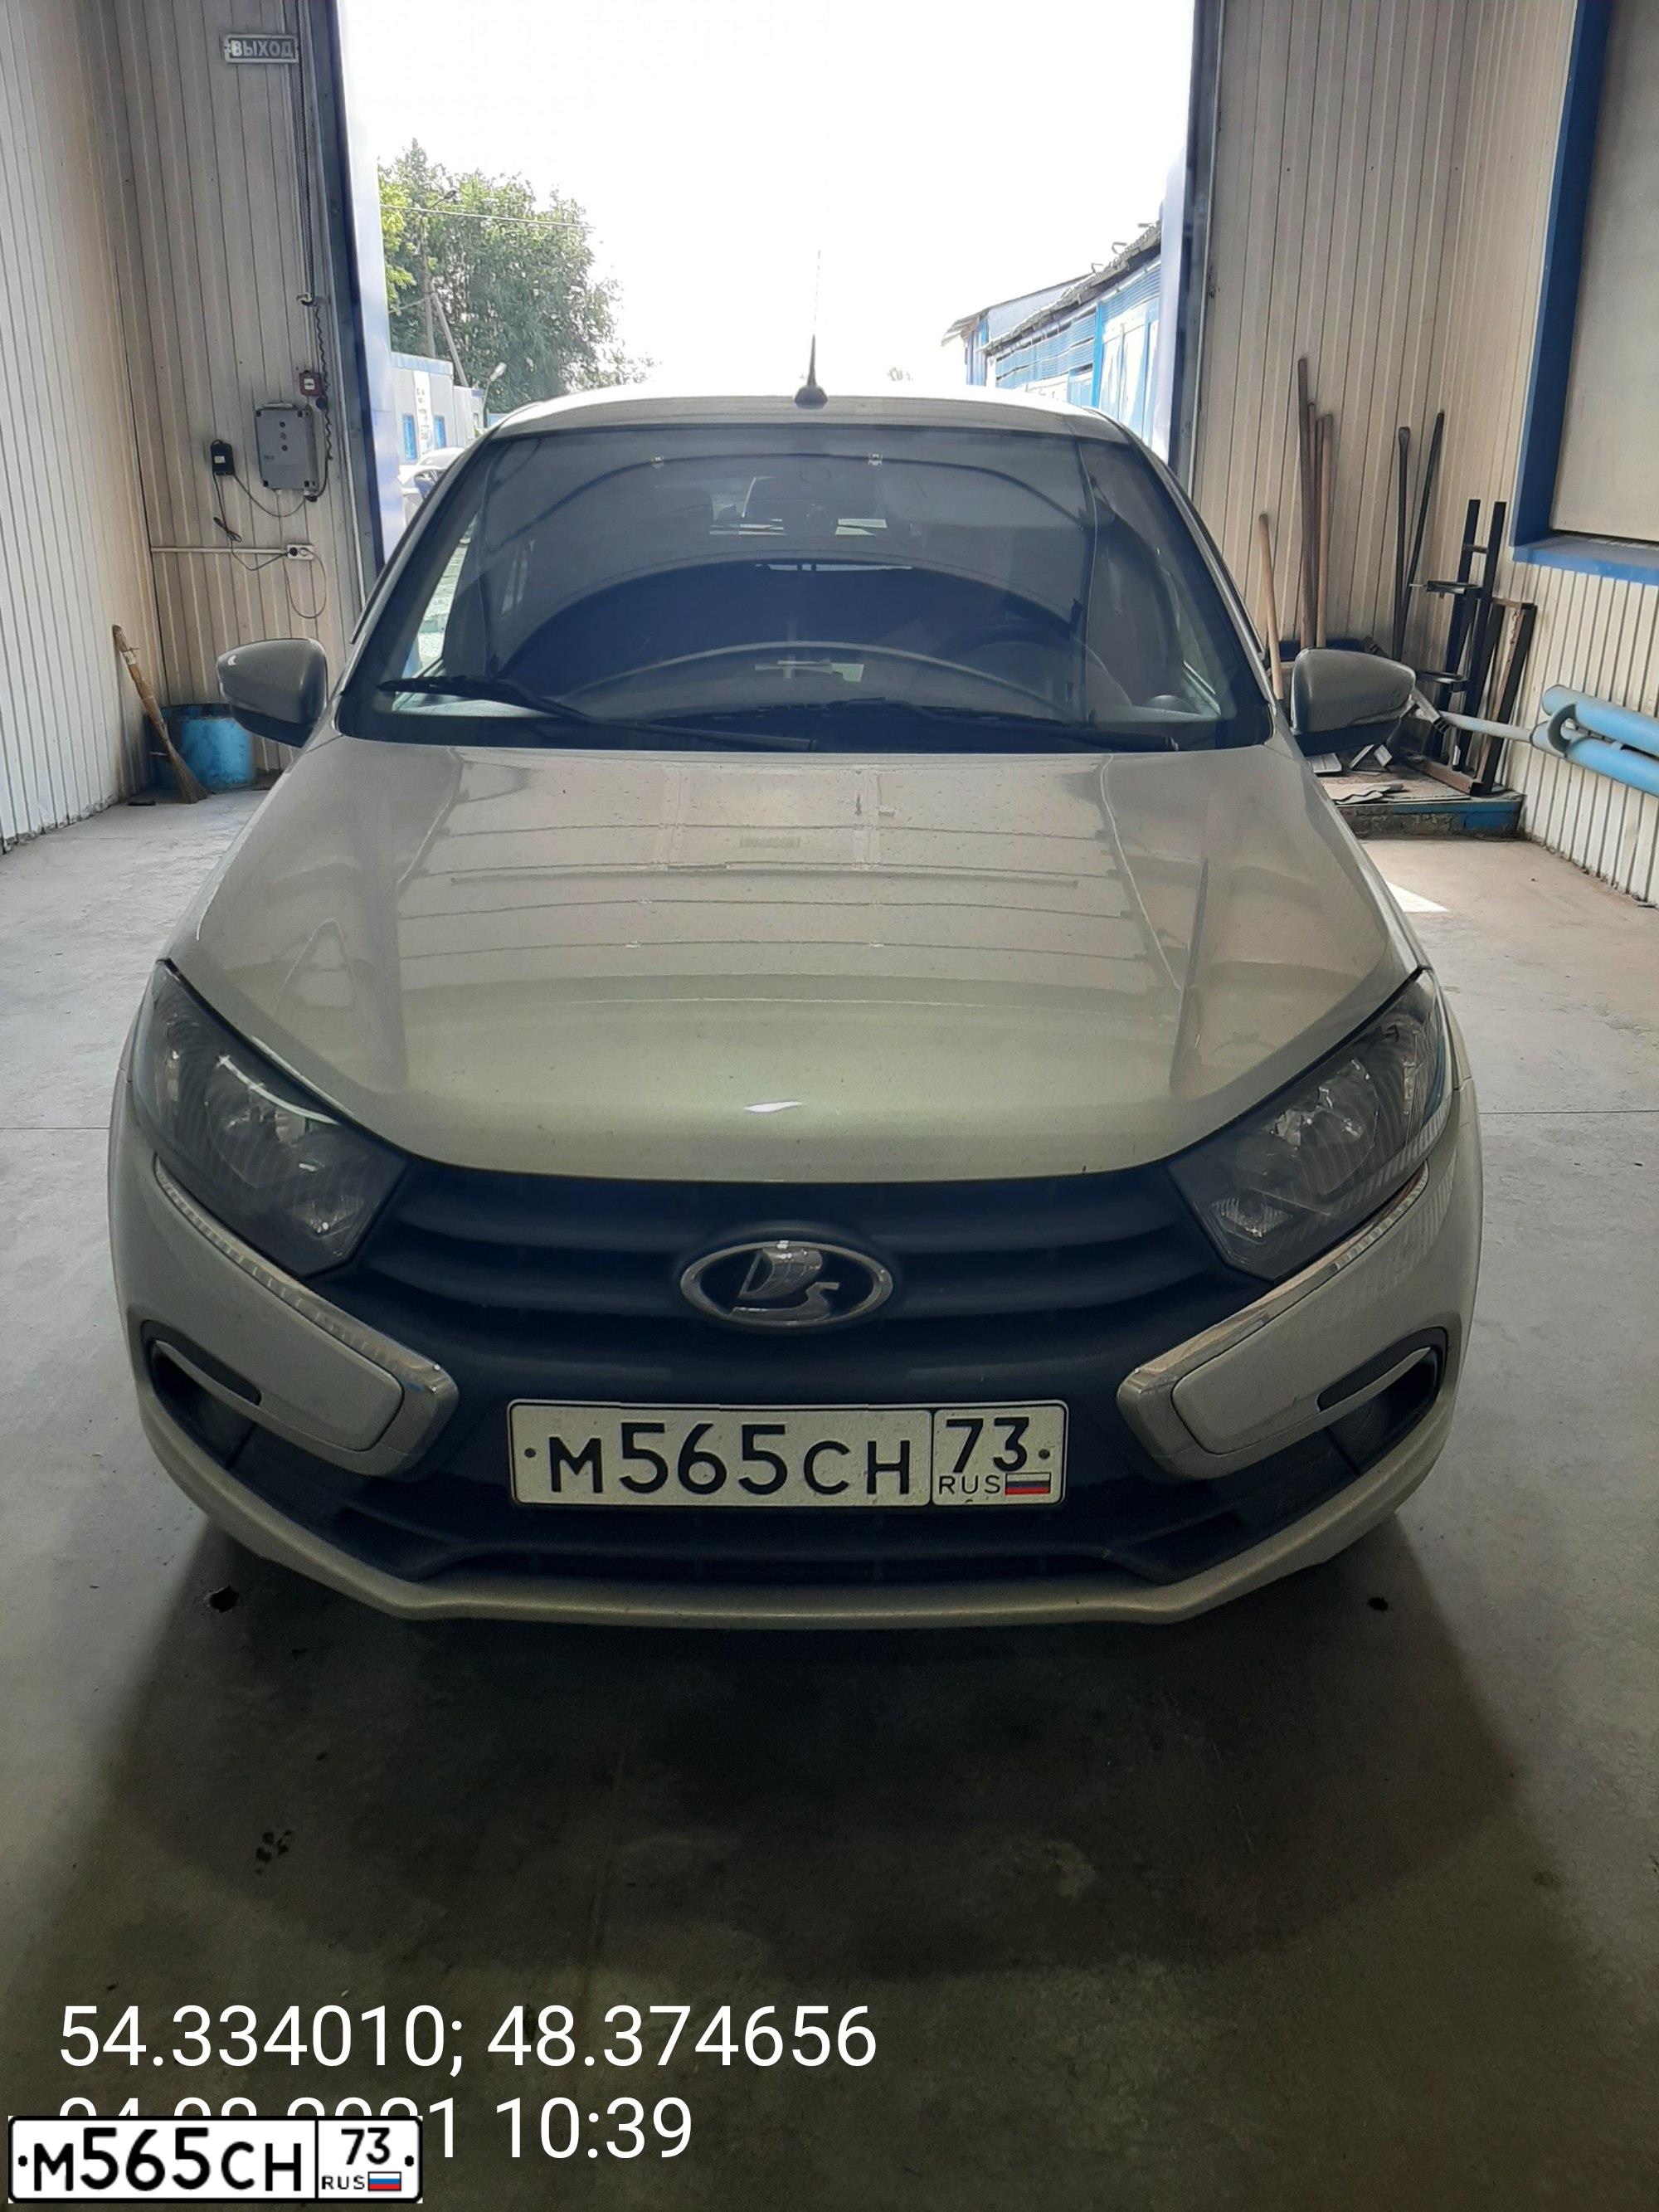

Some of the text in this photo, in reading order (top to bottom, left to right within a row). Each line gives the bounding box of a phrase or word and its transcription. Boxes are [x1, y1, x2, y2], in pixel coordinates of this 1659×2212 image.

[231, 40, 293, 57] ВЫХОД
[946, 1416, 1030, 1474] 73
[938, 1474, 1000, 1495] RUS
